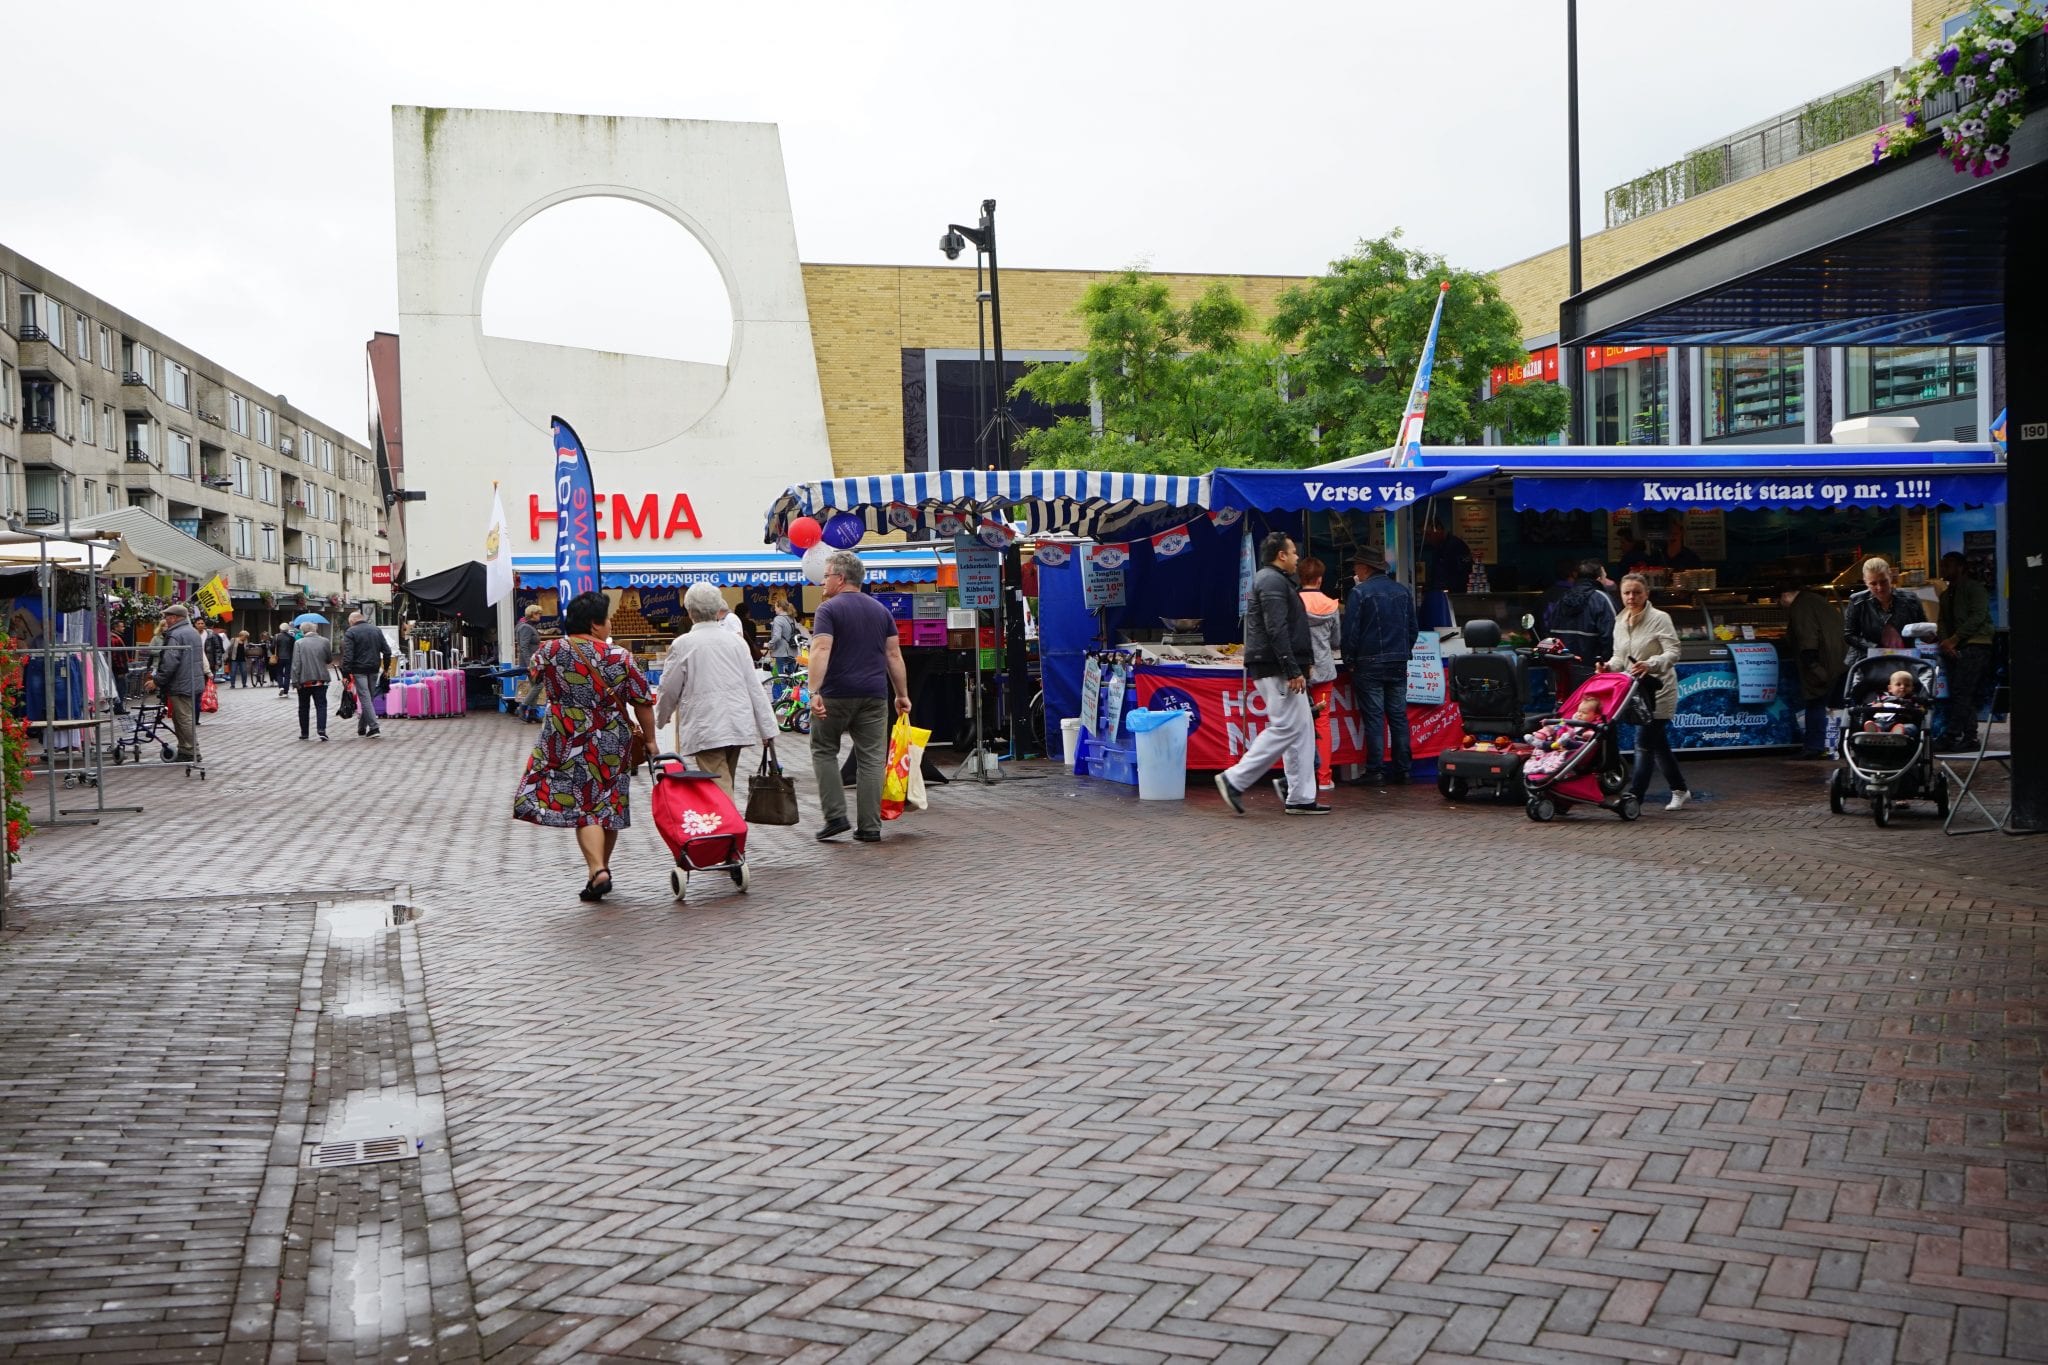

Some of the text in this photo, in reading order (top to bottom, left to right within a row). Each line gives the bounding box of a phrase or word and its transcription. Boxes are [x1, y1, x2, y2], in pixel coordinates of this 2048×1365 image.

[2024, 425, 2045, 438] 190
[1303, 481, 1416, 501] Verse vis
[1643, 480, 1931, 503] Kwaliteit staat op nr. 1!!!
[629, 573, 720, 584] DOPPENBERG
[728, 572, 748, 583] UW
[1163, 695, 1178, 706] ZE
[1672, 713, 1716, 728] William
[1701, 731, 1741, 741] Spakenburg
